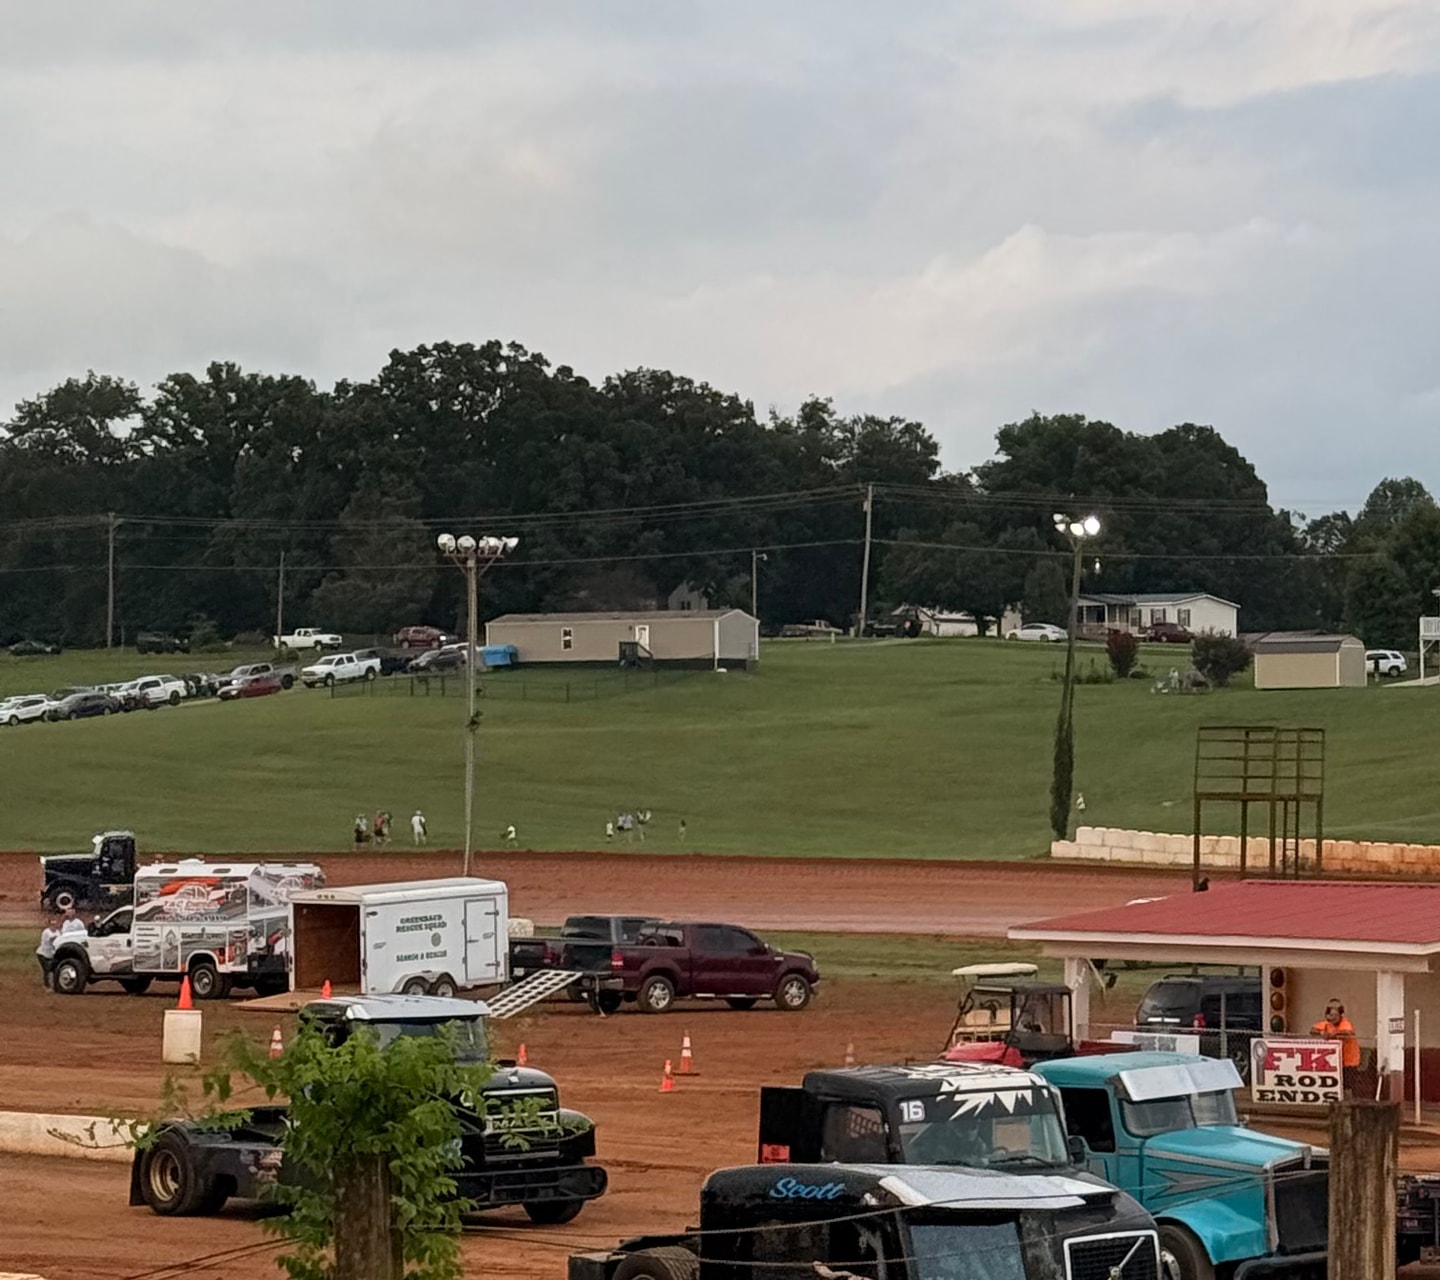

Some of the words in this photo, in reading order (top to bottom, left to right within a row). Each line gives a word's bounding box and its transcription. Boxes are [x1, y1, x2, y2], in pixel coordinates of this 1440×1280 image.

[1264, 1047, 1338, 1072] FK
[1274, 1074, 1339, 1088] ROD
[1256, 1089, 1339, 1103] ENDS
[900, 1100, 925, 1122] 16
[769, 1177, 845, 1200] Scott
